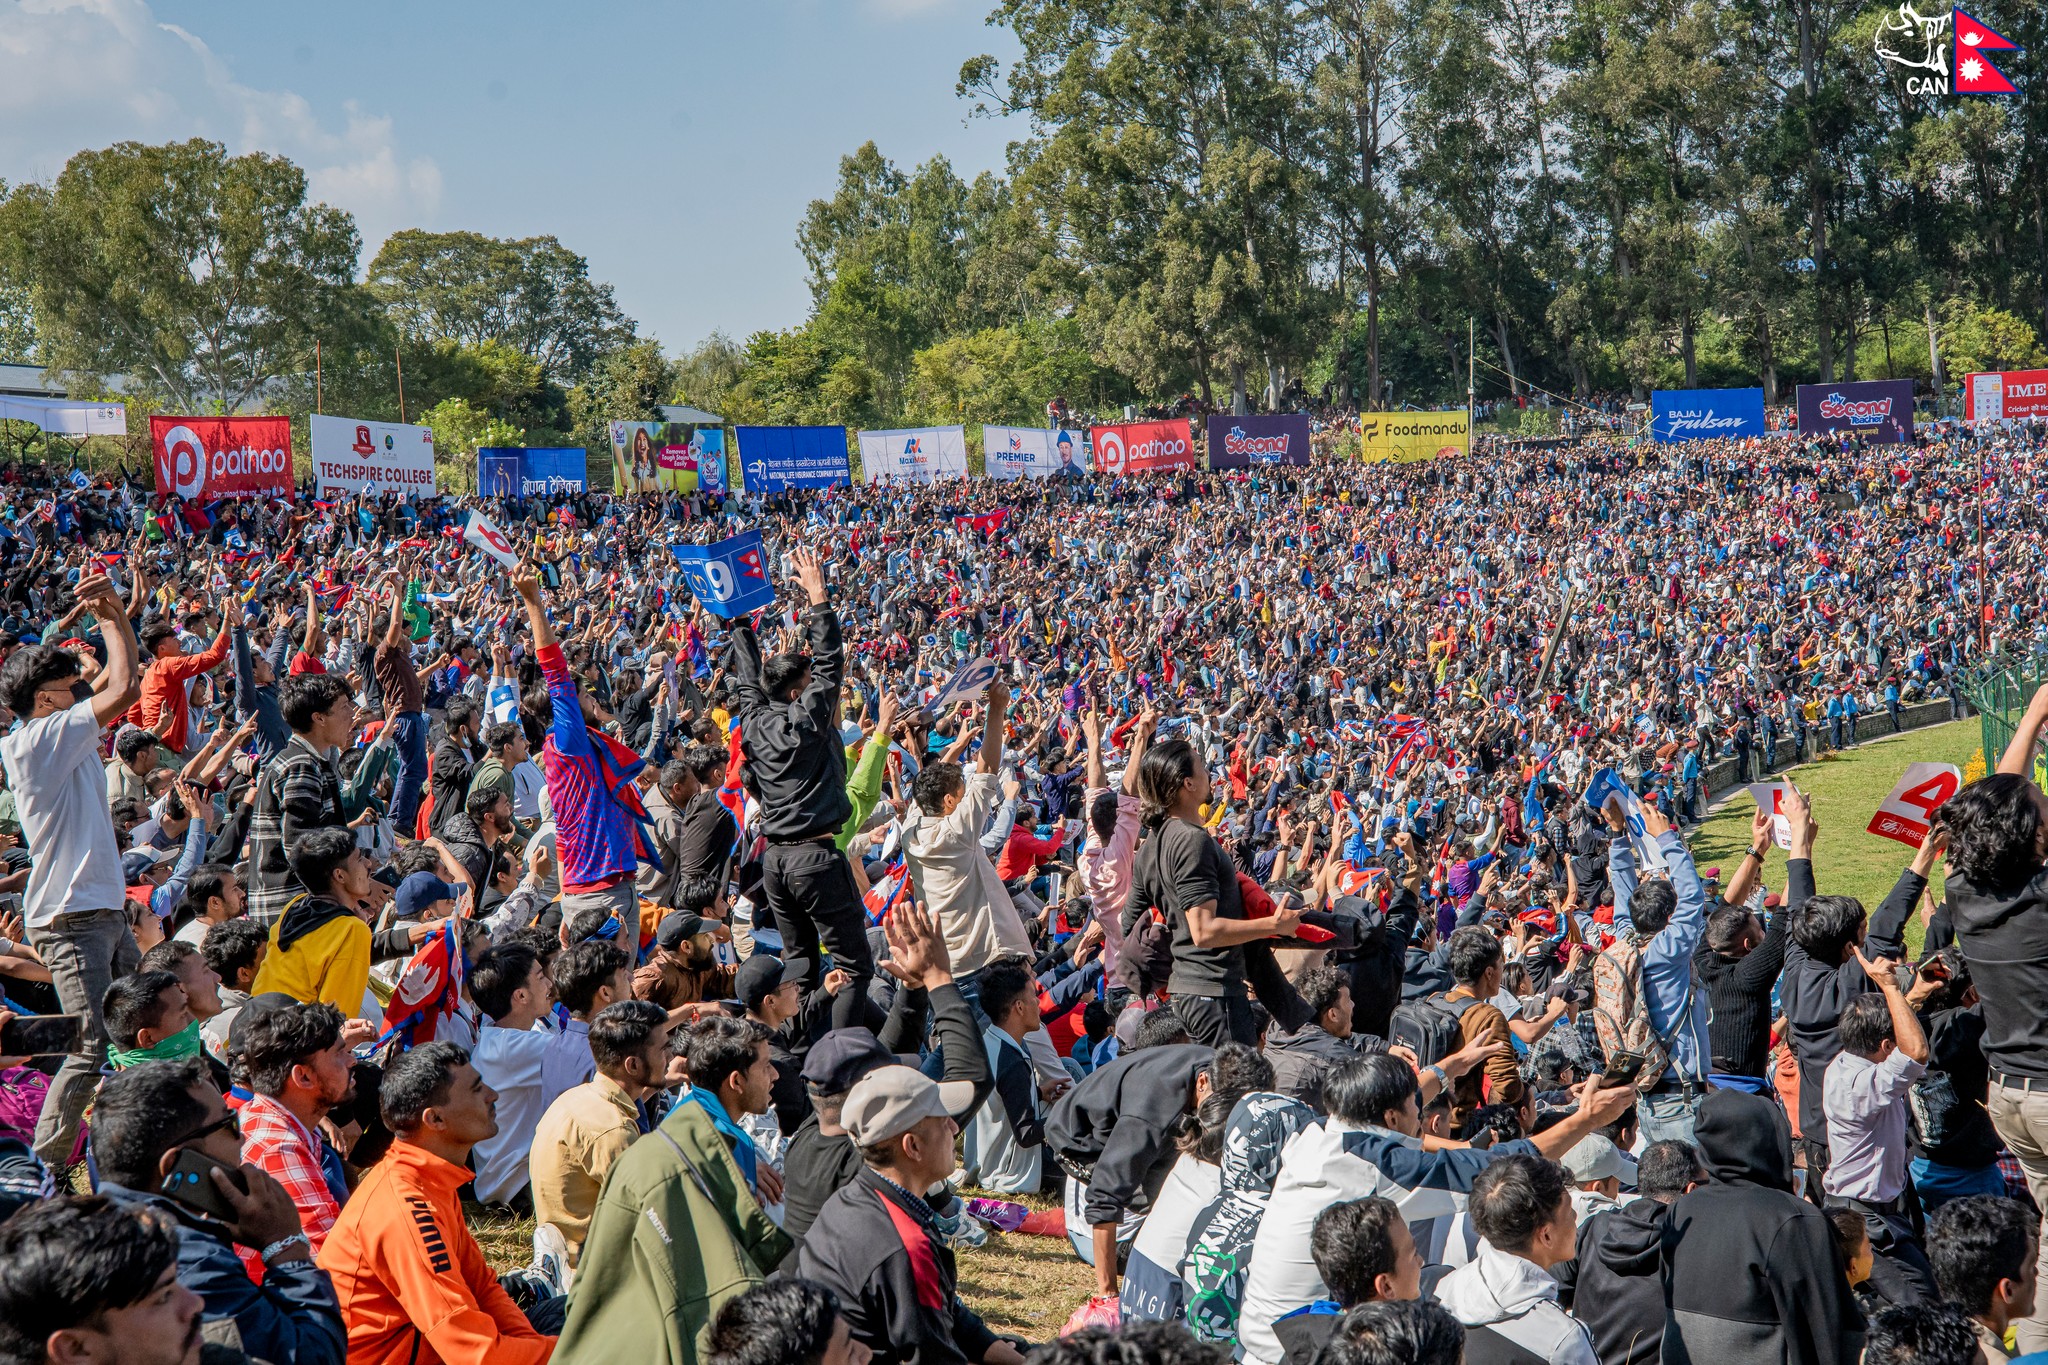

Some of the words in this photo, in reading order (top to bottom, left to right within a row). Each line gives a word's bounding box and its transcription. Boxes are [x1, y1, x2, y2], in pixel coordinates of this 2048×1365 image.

[2007, 383, 2047, 398] IME
[1828, 392, 1846, 405] My
[1820, 396, 1893, 418] Second
[2007, 404, 2029, 413] Cricket
[1668, 410, 1702, 418] BAJAJ
[1849, 414, 1884, 425] Teacher
[1385, 421, 1467, 436] Foodmandu
[1667, 408, 1749, 438] pulsar
[1231, 426, 1245, 439] My
[1129, 438, 1186, 462] pathao
[1225, 433, 1290, 454] Second
[211, 445, 286, 480] pathao
[996, 451, 1036, 462] PREMIER
[319, 461, 383, 482] TECHSPIRE
[385, 467, 433, 484] COLLEGE
[769, 471, 786, 479] NATIONAL
[786, 471, 795, 479] LIFE
[795, 470, 816, 478] INSURANCE
[816, 470, 833, 478] COMPANY
[834, 469, 849, 477] LIMITED
[75, 475, 87, 487] 6
[521, 476, 547, 495] नेपाल
[365, 485, 372, 495] 6
[383, 589, 391, 600] 6
[1641, 720, 1651, 732] OUT
[1900, 771, 1959, 820] 4
[1423, 799, 1430, 811] 6
